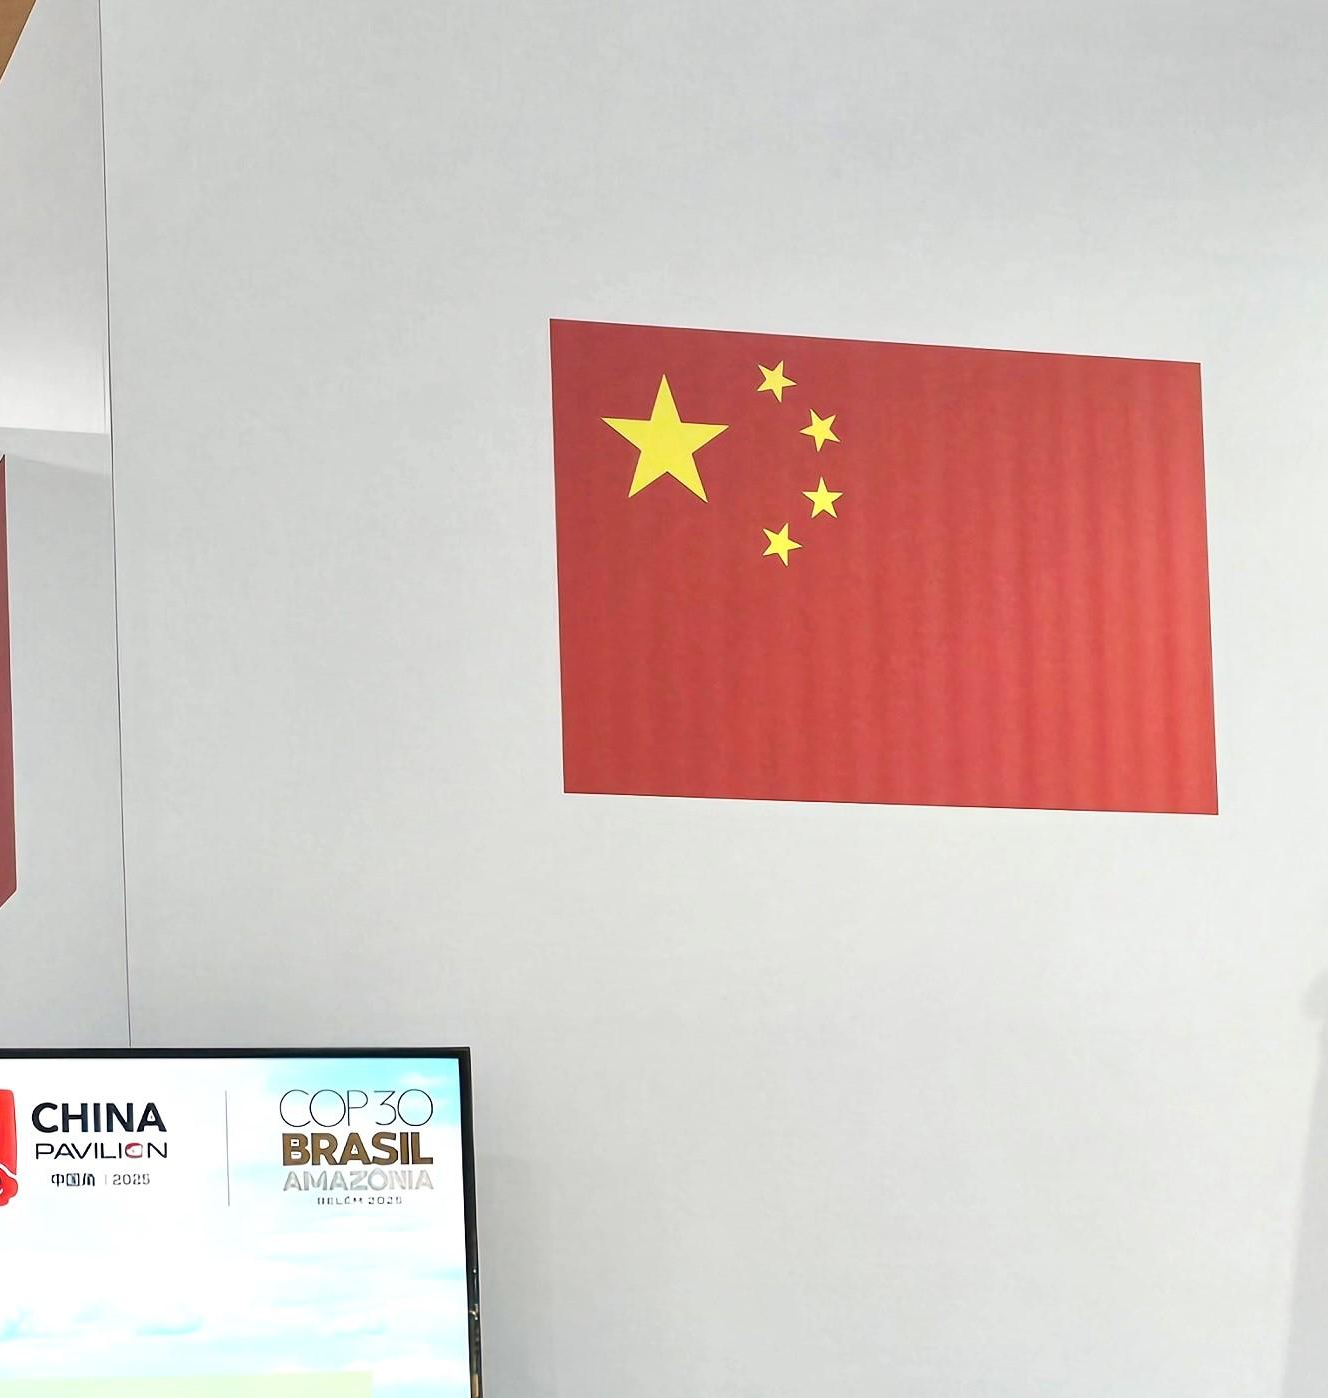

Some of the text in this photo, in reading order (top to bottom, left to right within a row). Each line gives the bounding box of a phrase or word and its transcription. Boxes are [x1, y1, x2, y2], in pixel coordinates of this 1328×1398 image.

[31, 1102, 167, 1134] CHINA
[36, 1142, 167, 1160] PAVILION
[282, 1133, 434, 1166] BRASIL
[112, 1174, 150, 1186] 2025
[283, 1169, 434, 1192] AMAZÔNIA
